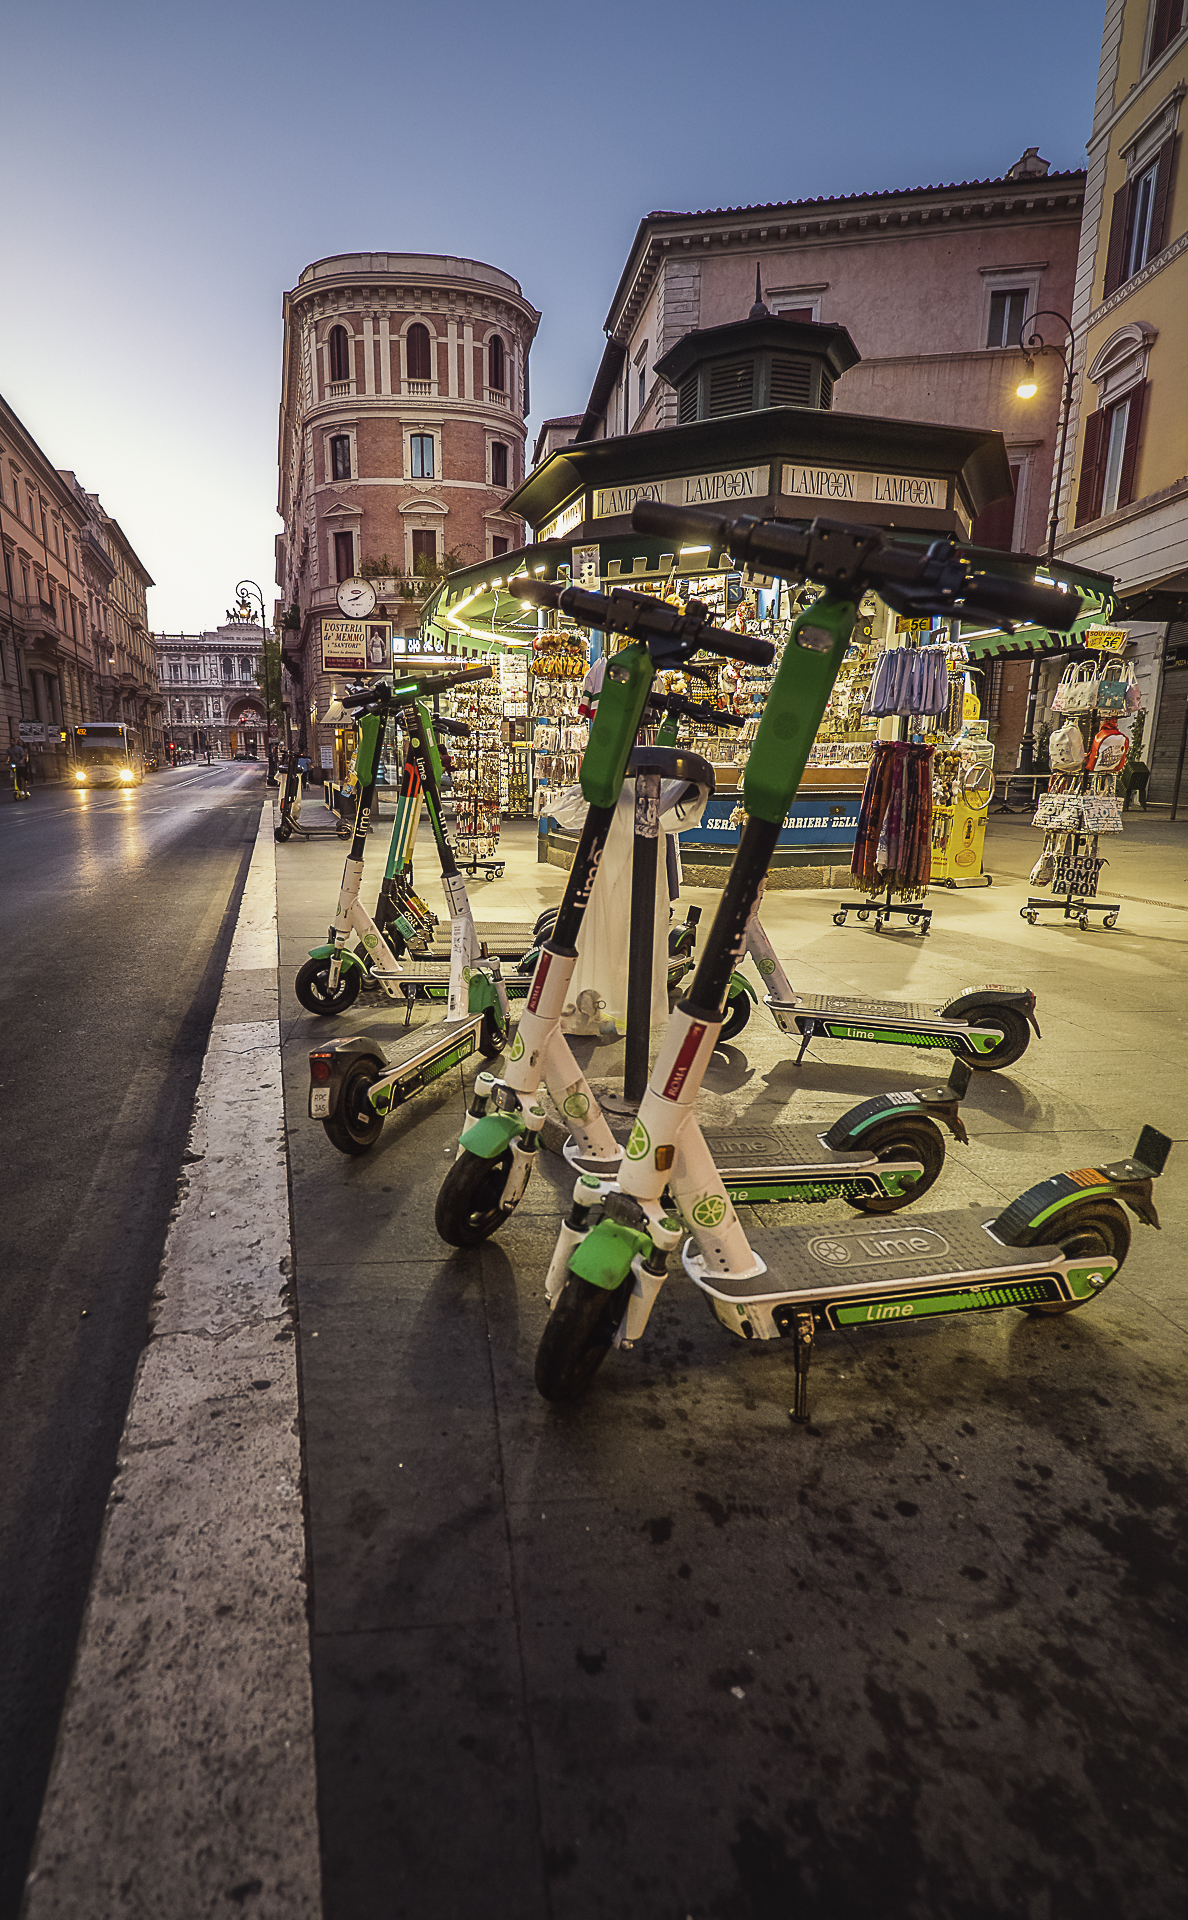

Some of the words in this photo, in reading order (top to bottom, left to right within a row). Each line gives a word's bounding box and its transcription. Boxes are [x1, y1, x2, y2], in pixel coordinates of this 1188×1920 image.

[685, 471, 755, 503] LAMPOON
[791, 469, 855, 498] LAMPOON
[875, 477, 936, 504] LAMPOON
[324, 622, 362, 633] L'OSTERIA
[910, 618, 929, 631] 5€
[335, 633, 365, 642] MEMMO
[1102, 636, 1121, 649] 5€
[76, 728, 87, 736] 492
[416, 757, 427, 781] Lime
[356, 807, 371, 838] Lime
[706, 818, 737, 831] SERA
[782, 816, 828, 829] ORRIERE
[831, 816, 858, 828] DELL
[403, 911, 418, 927] dott
[847, 1027, 875, 1039] Lime
[667, 1066, 687, 1097] ROMA
[857, 1237, 931, 1257] Lime
[867, 1304, 914, 1321] Lime
